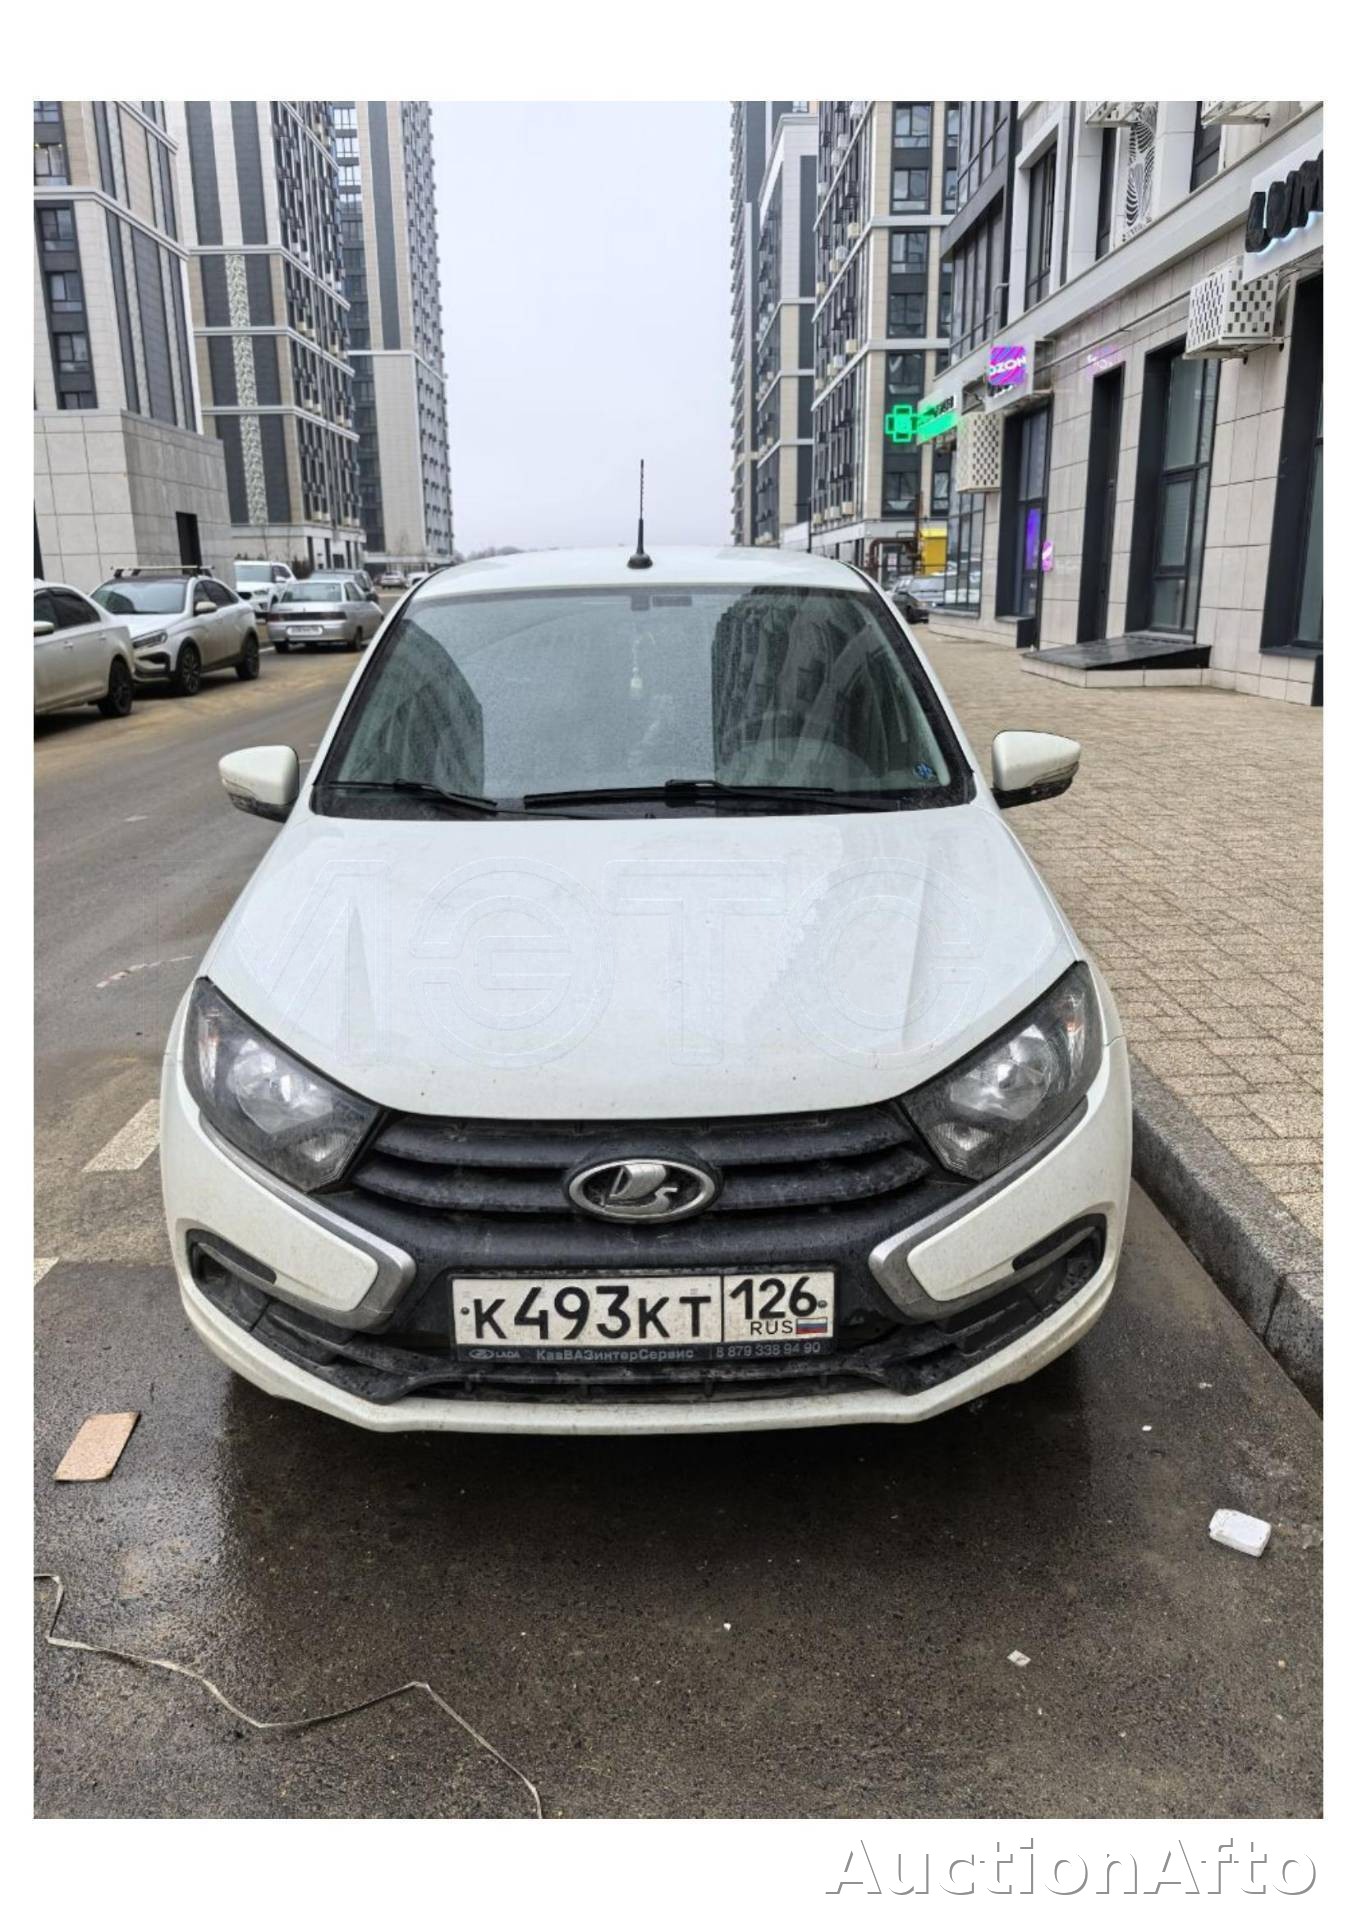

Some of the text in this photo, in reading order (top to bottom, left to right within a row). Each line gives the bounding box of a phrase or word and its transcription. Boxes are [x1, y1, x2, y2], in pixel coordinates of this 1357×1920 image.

[987, 356, 1027, 376] OZON
[474, 1276, 818, 1340] К493КТ 126
[749, 1320, 794, 1336] RUS
[495, 1351, 521, 1360] LADA
[715, 1346, 725, 1359] 8
